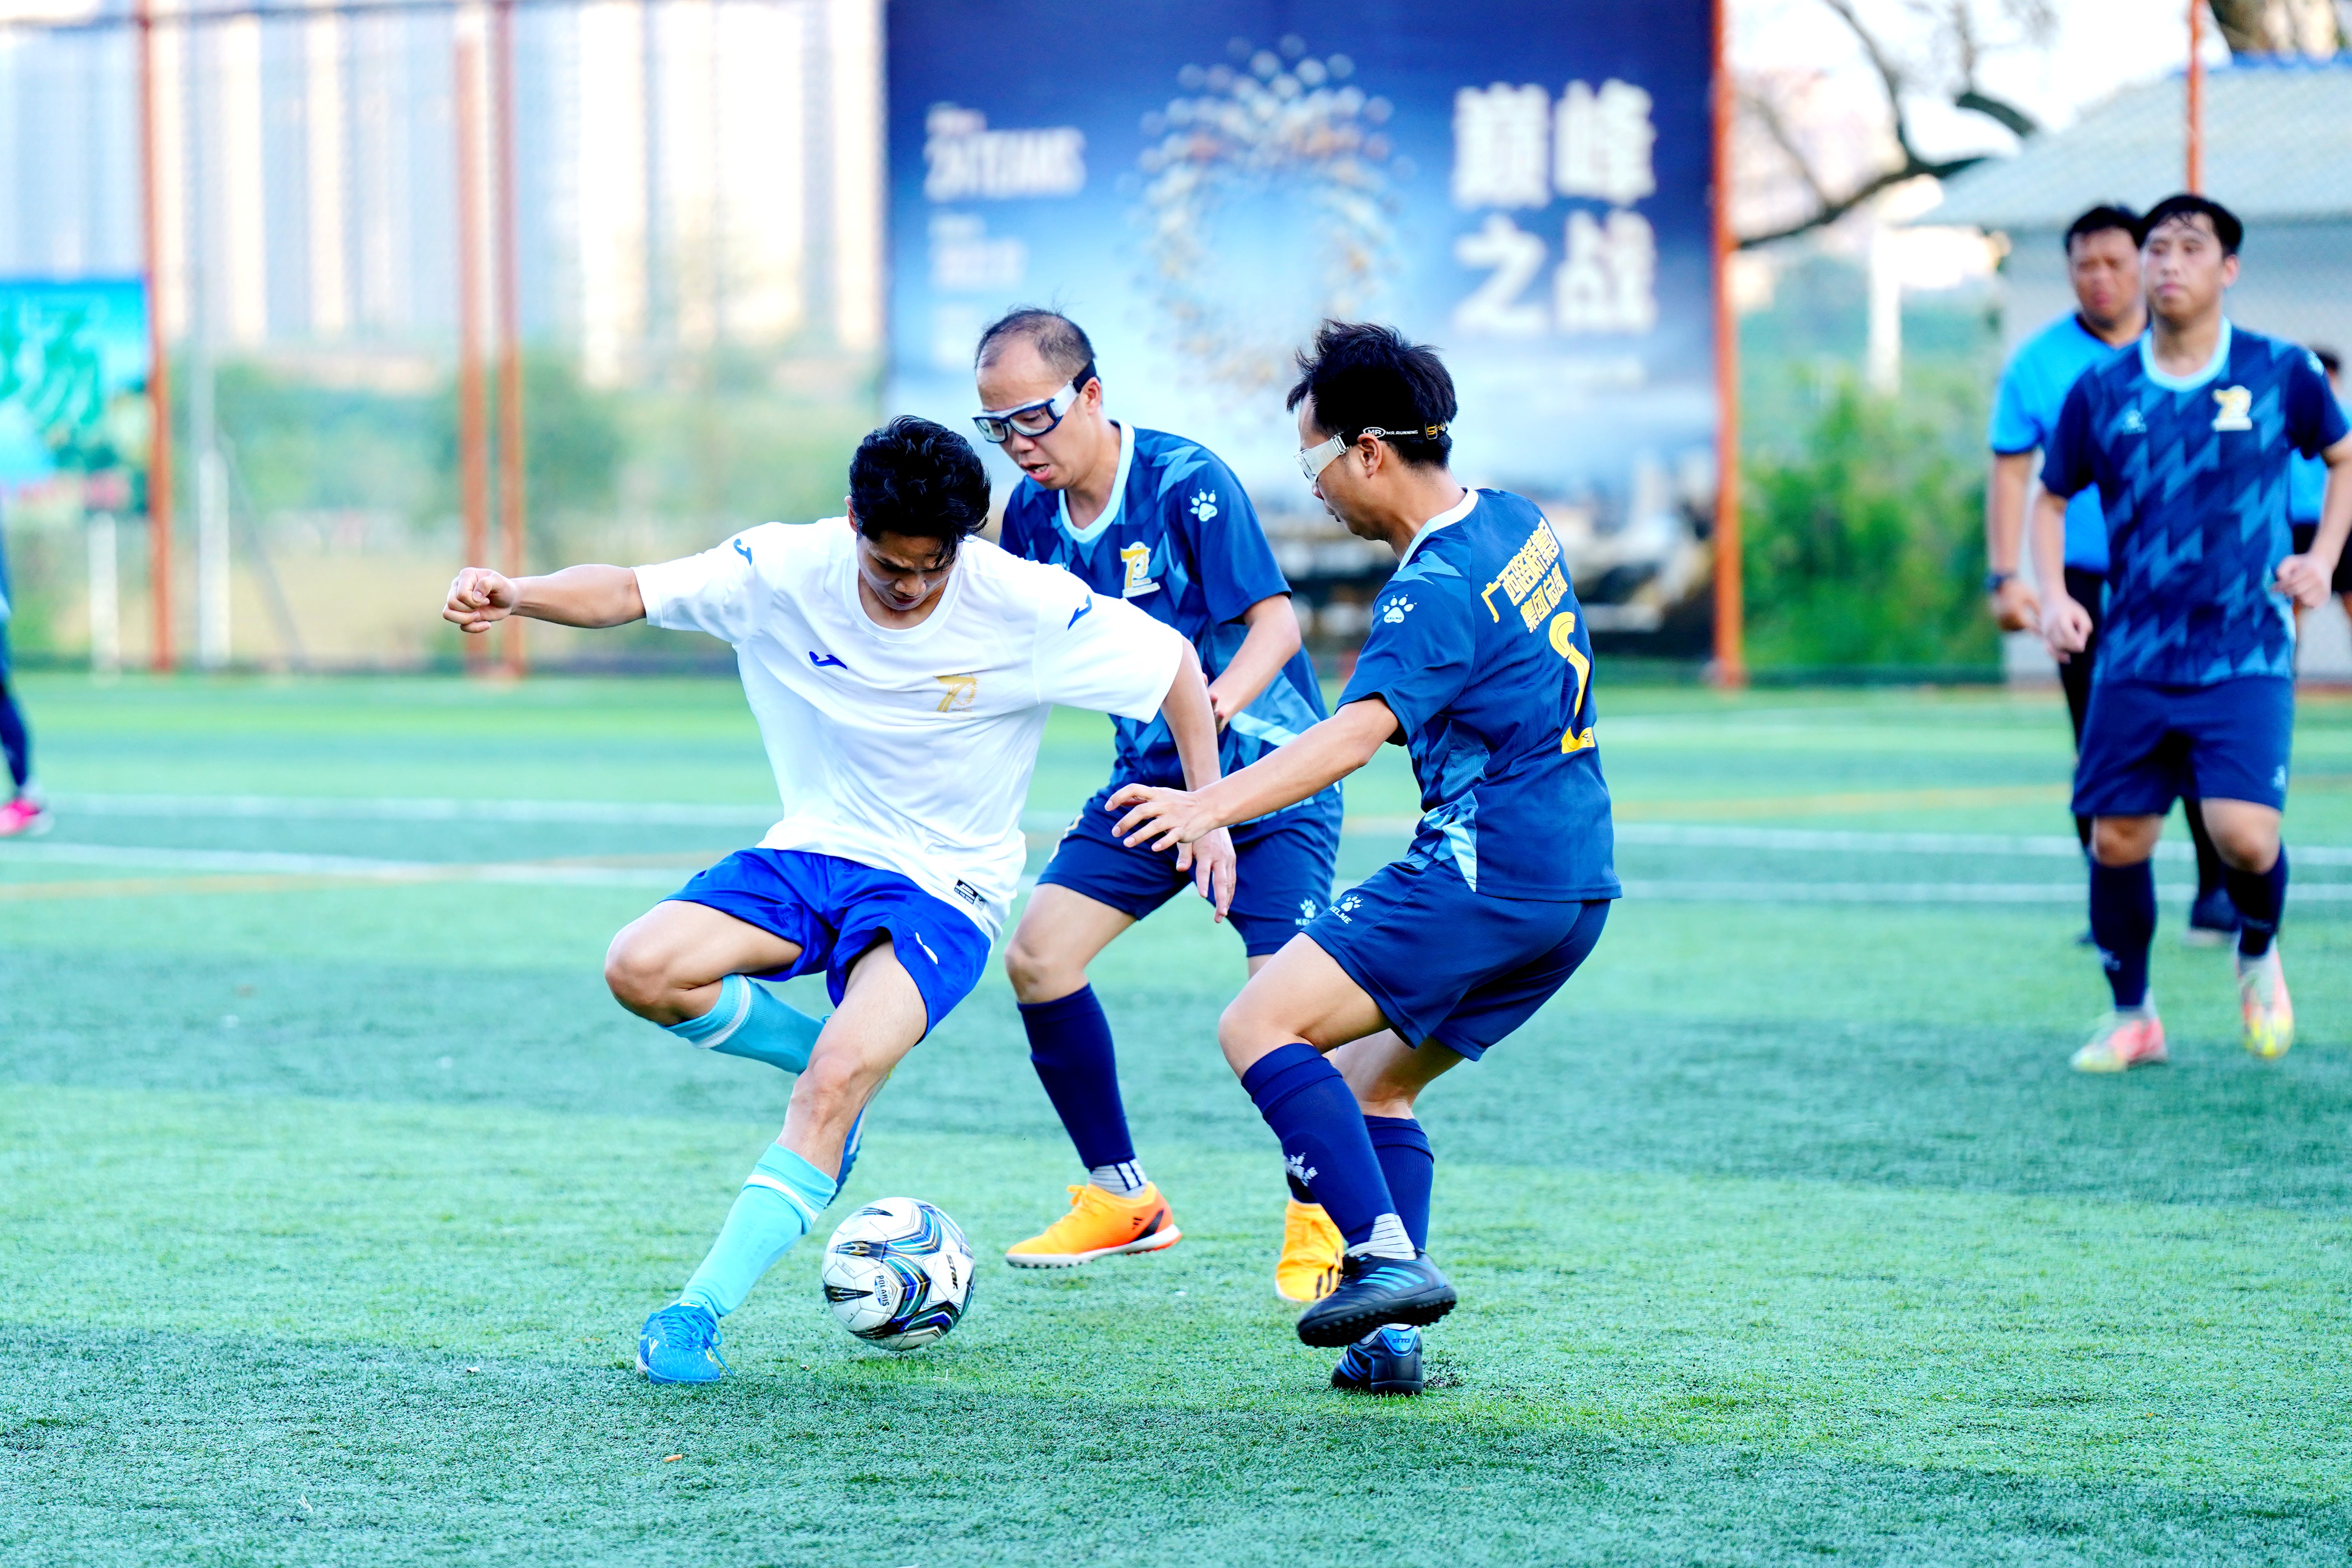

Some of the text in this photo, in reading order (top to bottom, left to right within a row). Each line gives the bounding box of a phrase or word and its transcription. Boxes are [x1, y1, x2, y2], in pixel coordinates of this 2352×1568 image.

[1520, 562, 1568, 633] 集团总部
[1329, 906, 1352, 924] KELME
[876, 1275, 890, 1306] POLARIS
